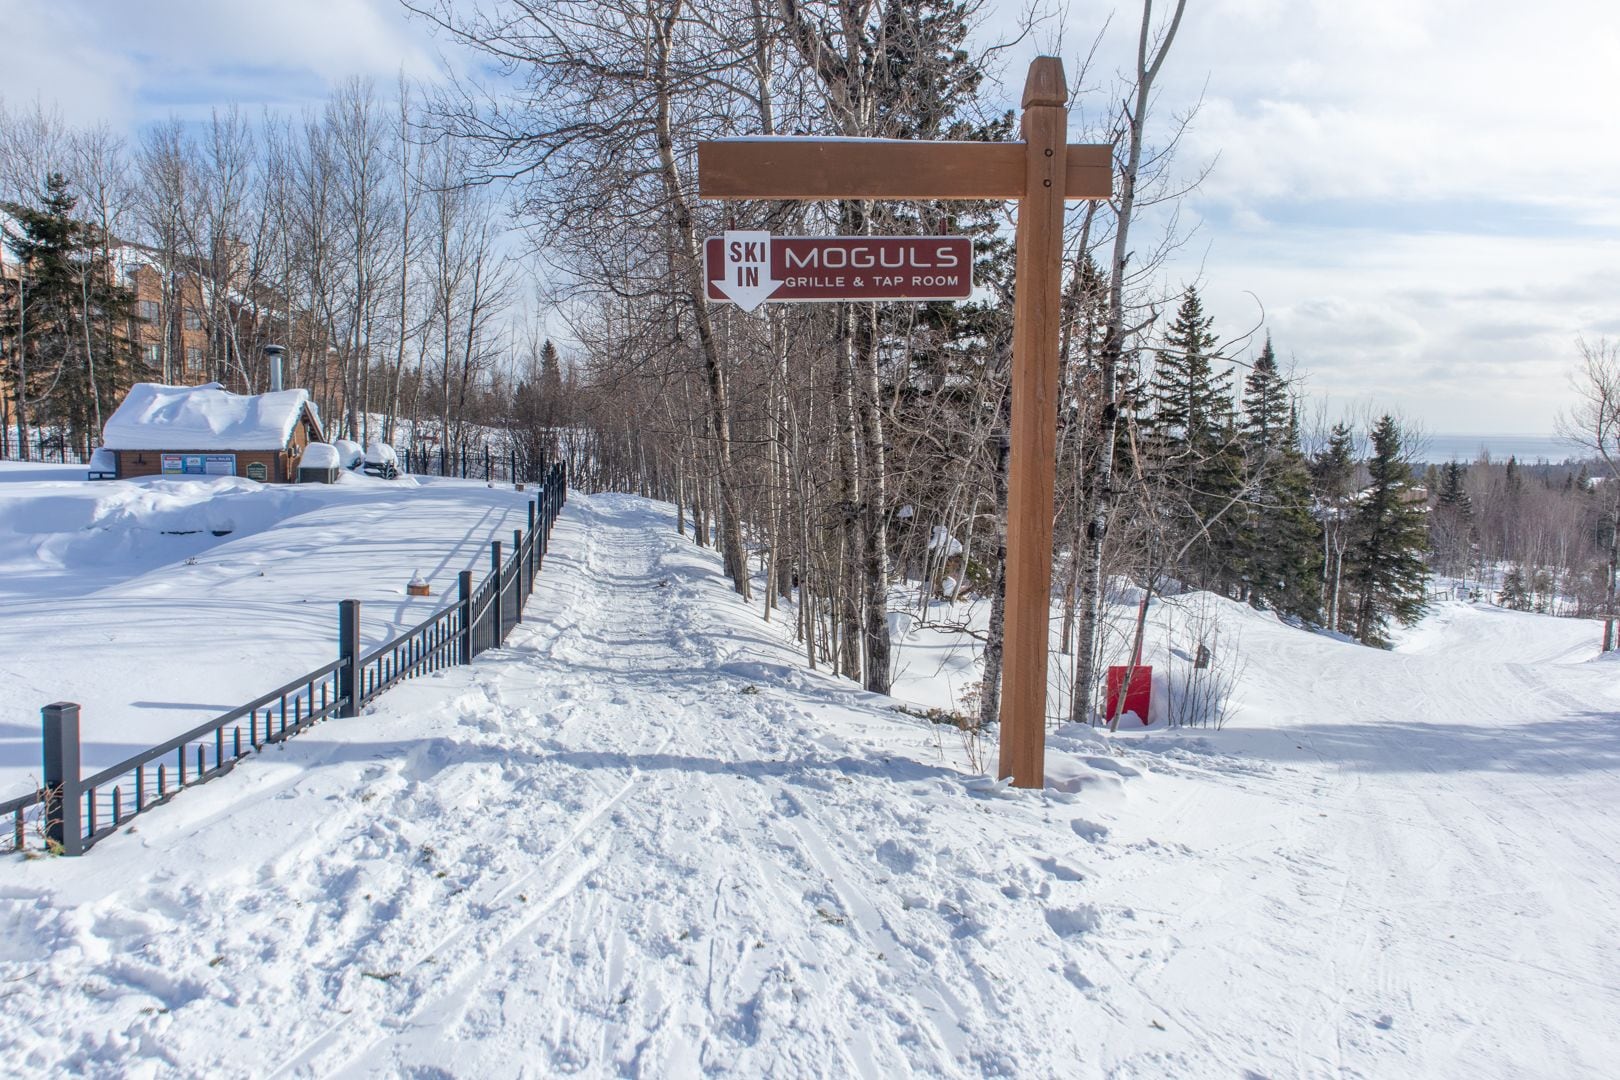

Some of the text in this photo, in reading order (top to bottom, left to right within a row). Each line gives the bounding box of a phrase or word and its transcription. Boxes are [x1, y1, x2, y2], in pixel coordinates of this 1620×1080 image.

[729, 241, 766, 263] SKI
[785, 247, 958, 268] MOGULS
[737, 266, 759, 287] IN
[785, 275, 958, 287] GRILLE & TAP ROOM
